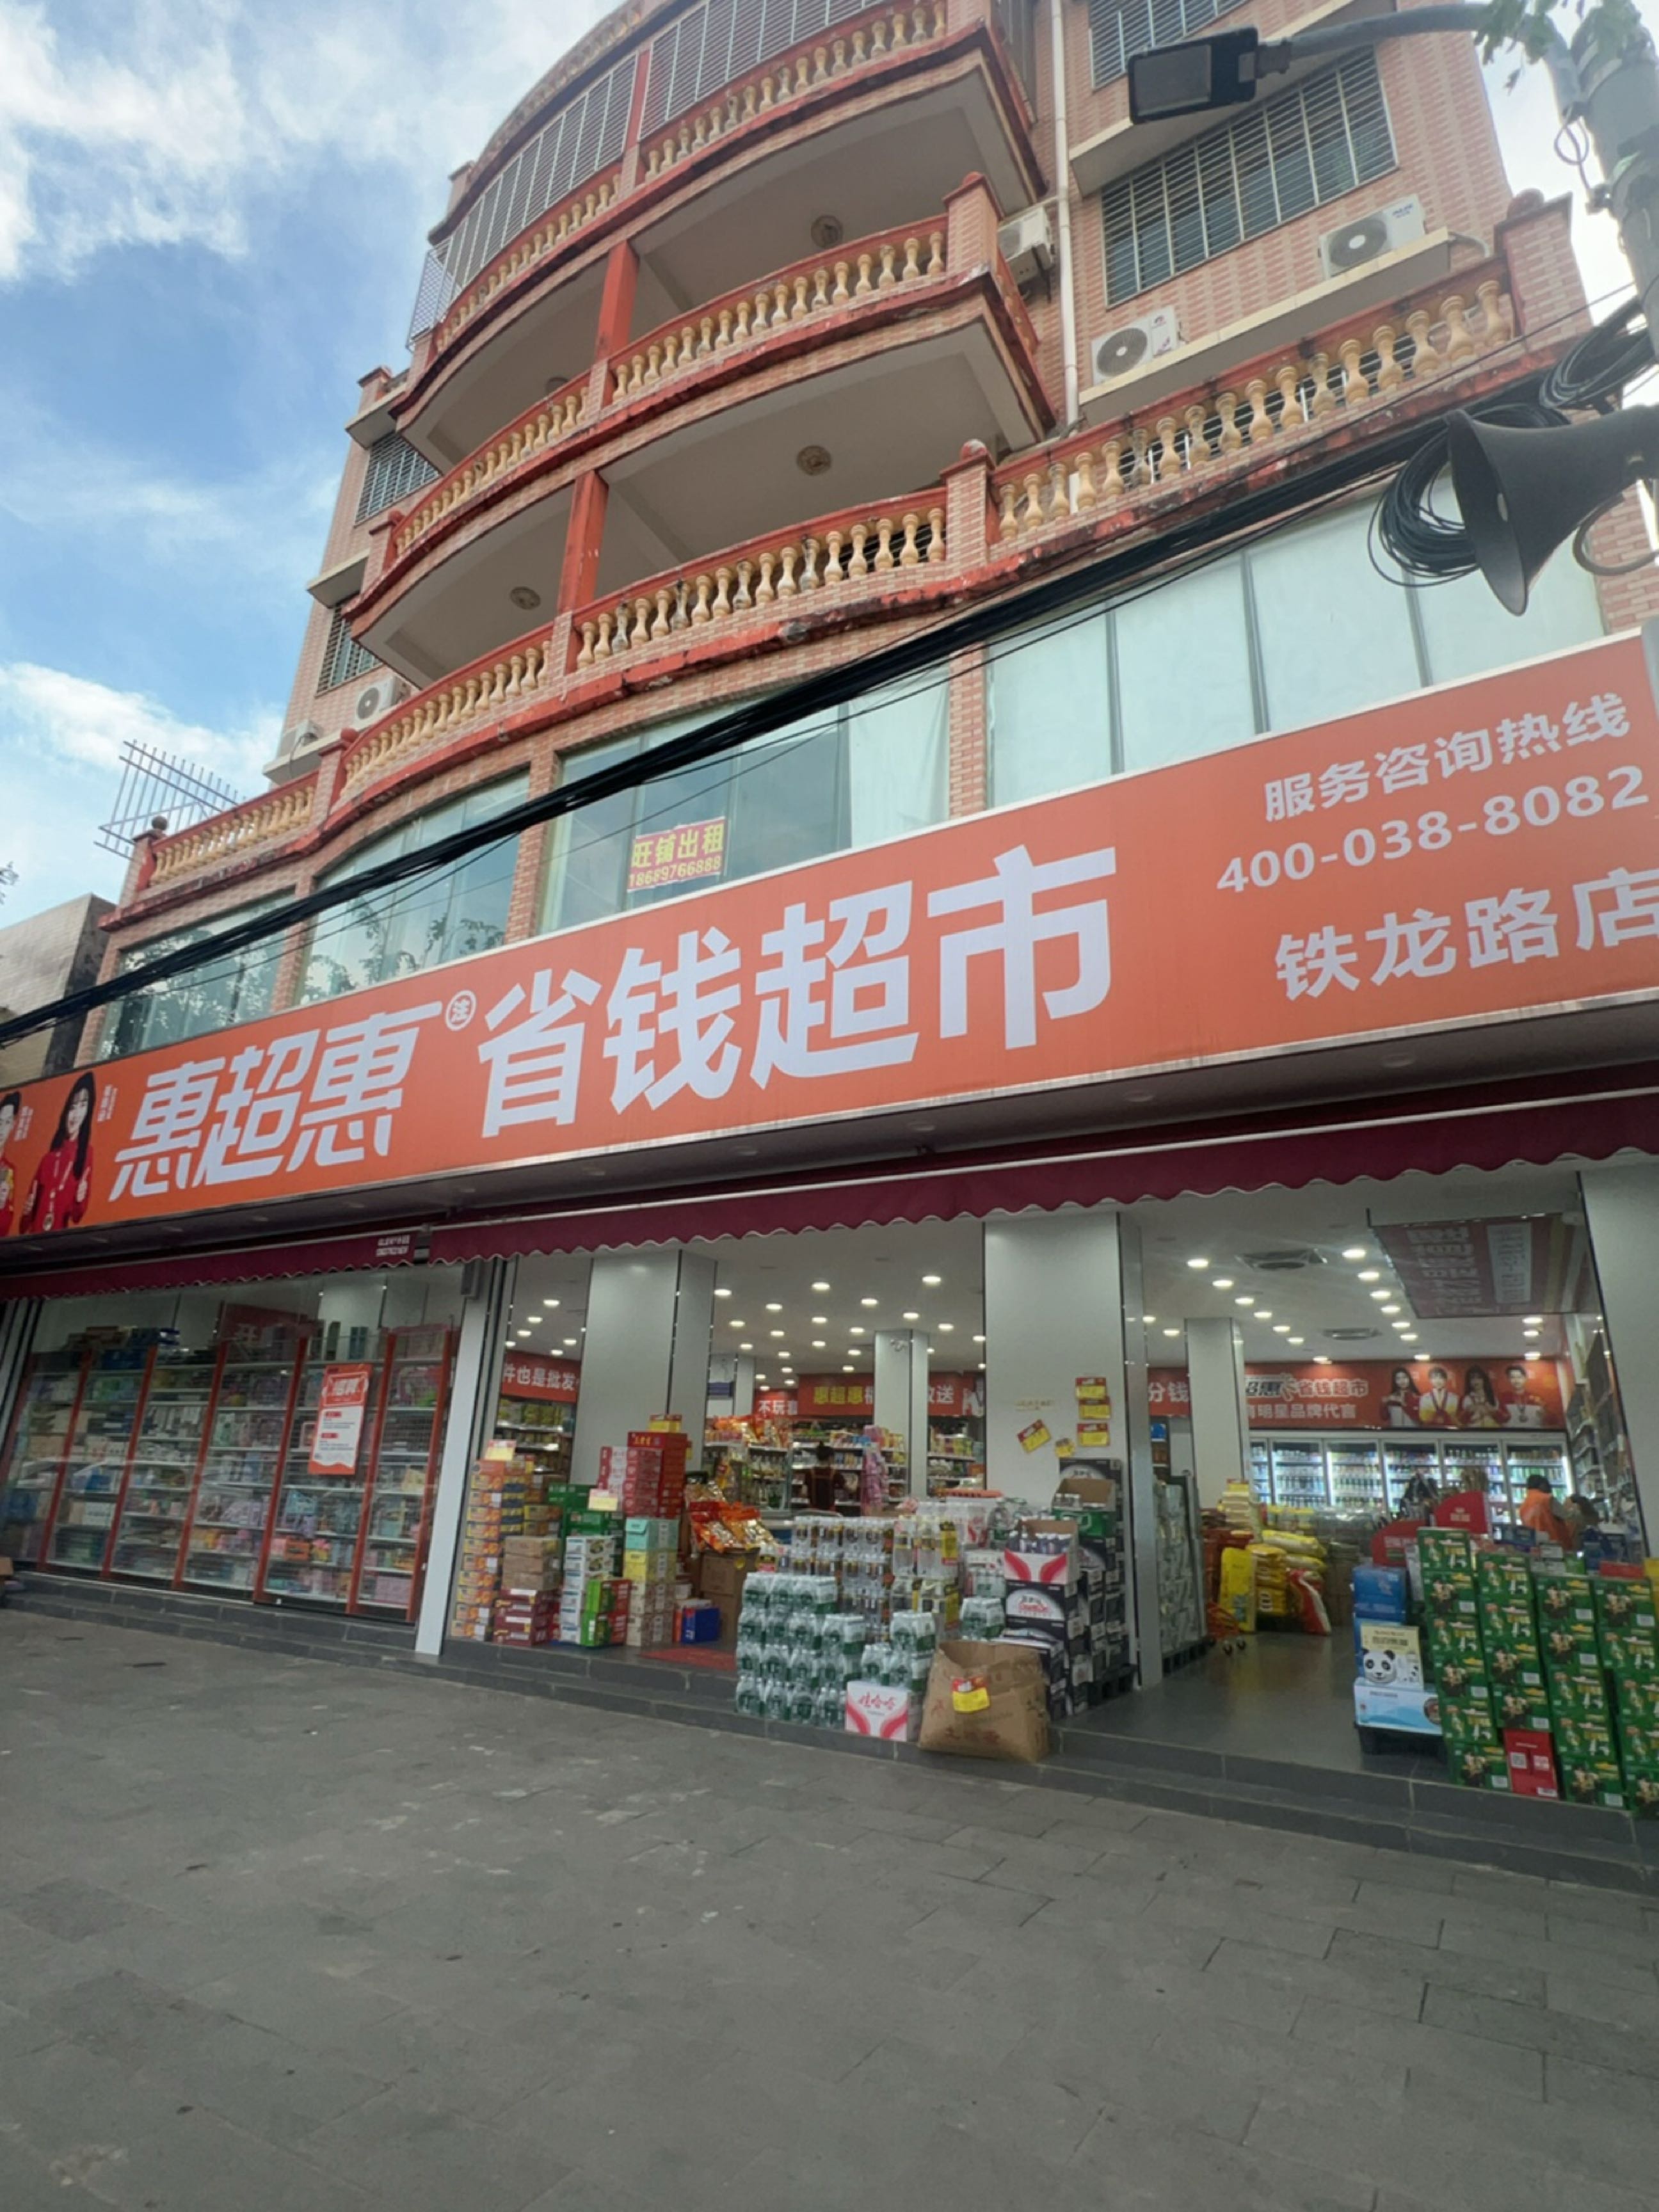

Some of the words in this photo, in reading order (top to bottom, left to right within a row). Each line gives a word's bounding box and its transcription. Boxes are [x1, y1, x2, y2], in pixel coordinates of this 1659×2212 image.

[1263, 692, 1631, 822] 服务咨询热线
[631, 823, 724, 868] 旺铺出租
[1217, 766, 1649, 893] 400-038-8082
[477, 844, 1116, 1139] 省钱超市
[1275, 867, 1659, 1001] 铁龙路店
